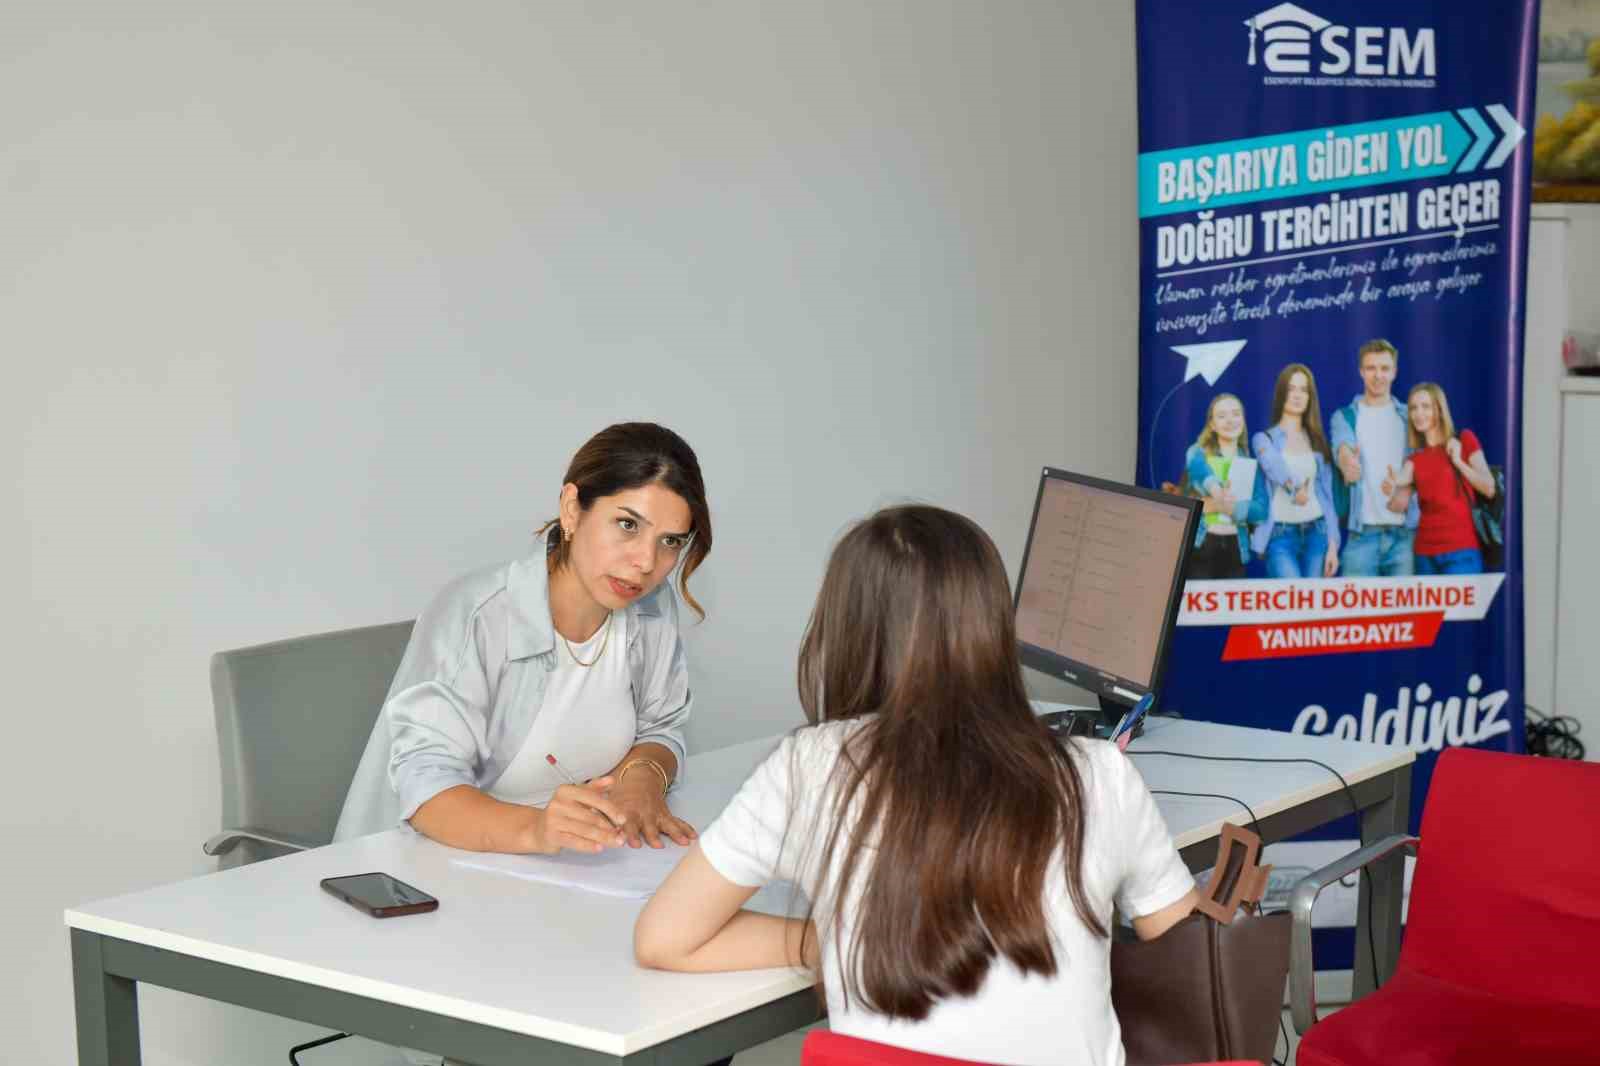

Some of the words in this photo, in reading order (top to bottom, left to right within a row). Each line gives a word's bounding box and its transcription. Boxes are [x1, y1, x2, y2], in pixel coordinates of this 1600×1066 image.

[1158, 144, 1298, 204] BAŞARIYA
[1307, 130, 1389, 182] GİDEN
[1397, 124, 1448, 170] YOL
[1157, 209, 1253, 268] DOĞRU
[1261, 192, 1408, 253] TERCİHTEN
[1417, 179, 1500, 238] GEÇER
[1211, 267, 1260, 297] rehber
[1381, 248, 1398, 271] ile
[1360, 276, 1382, 303] bir
[1434, 265, 1483, 300] geliyor
[1183, 591, 1219, 612] KS
[1225, 585, 1314, 611] TERCİH
[1321, 582, 1475, 609] DÖNEMİNDE
[1257, 621, 1415, 649] YANINIZDAYIZ
